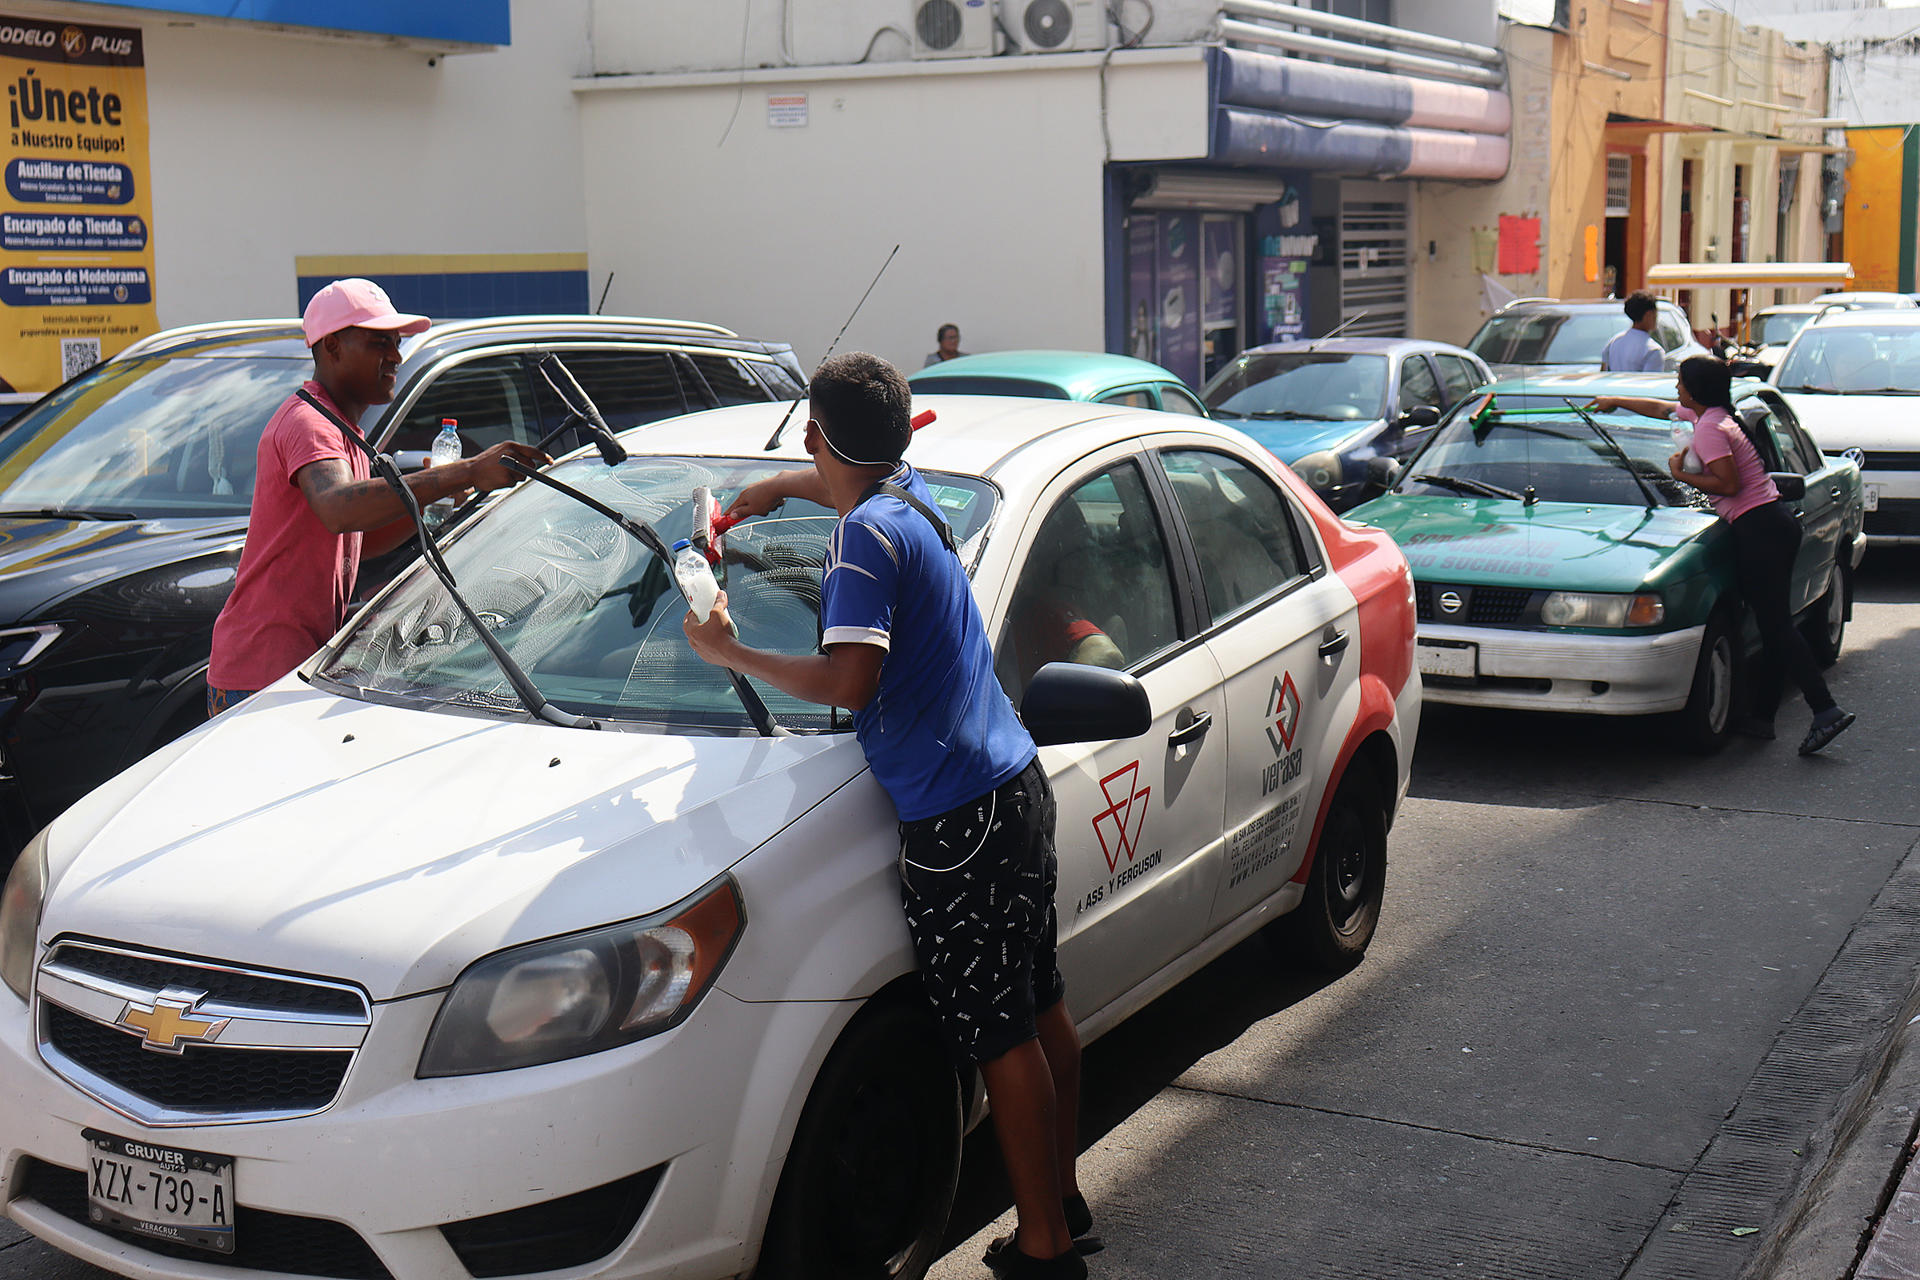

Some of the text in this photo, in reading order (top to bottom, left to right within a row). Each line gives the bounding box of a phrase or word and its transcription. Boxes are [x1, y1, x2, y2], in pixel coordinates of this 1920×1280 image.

[0, 26, 132, 55] ODELO PLUS
[8, 68, 122, 128] ¡Únete
[12, 131, 125, 153] a Nuestro Equipo!
[18, 161, 122, 182] Auxiliar de Tienda
[4, 216, 123, 235] Encargado de Tienda
[9, 269, 145, 285] Encargado de Modelorama
[1440, 557, 1554, 577] SUCHIATE
[1262, 748, 1302, 797] verasa
[1109, 878, 1115, 894] Y
[1117, 849, 1162, 890] FERGUSON
[125, 1143, 185, 1165] GRUVER
[91, 1157, 225, 1225] XZX-739-A
[140, 1221, 177, 1236] VERACRUZ
